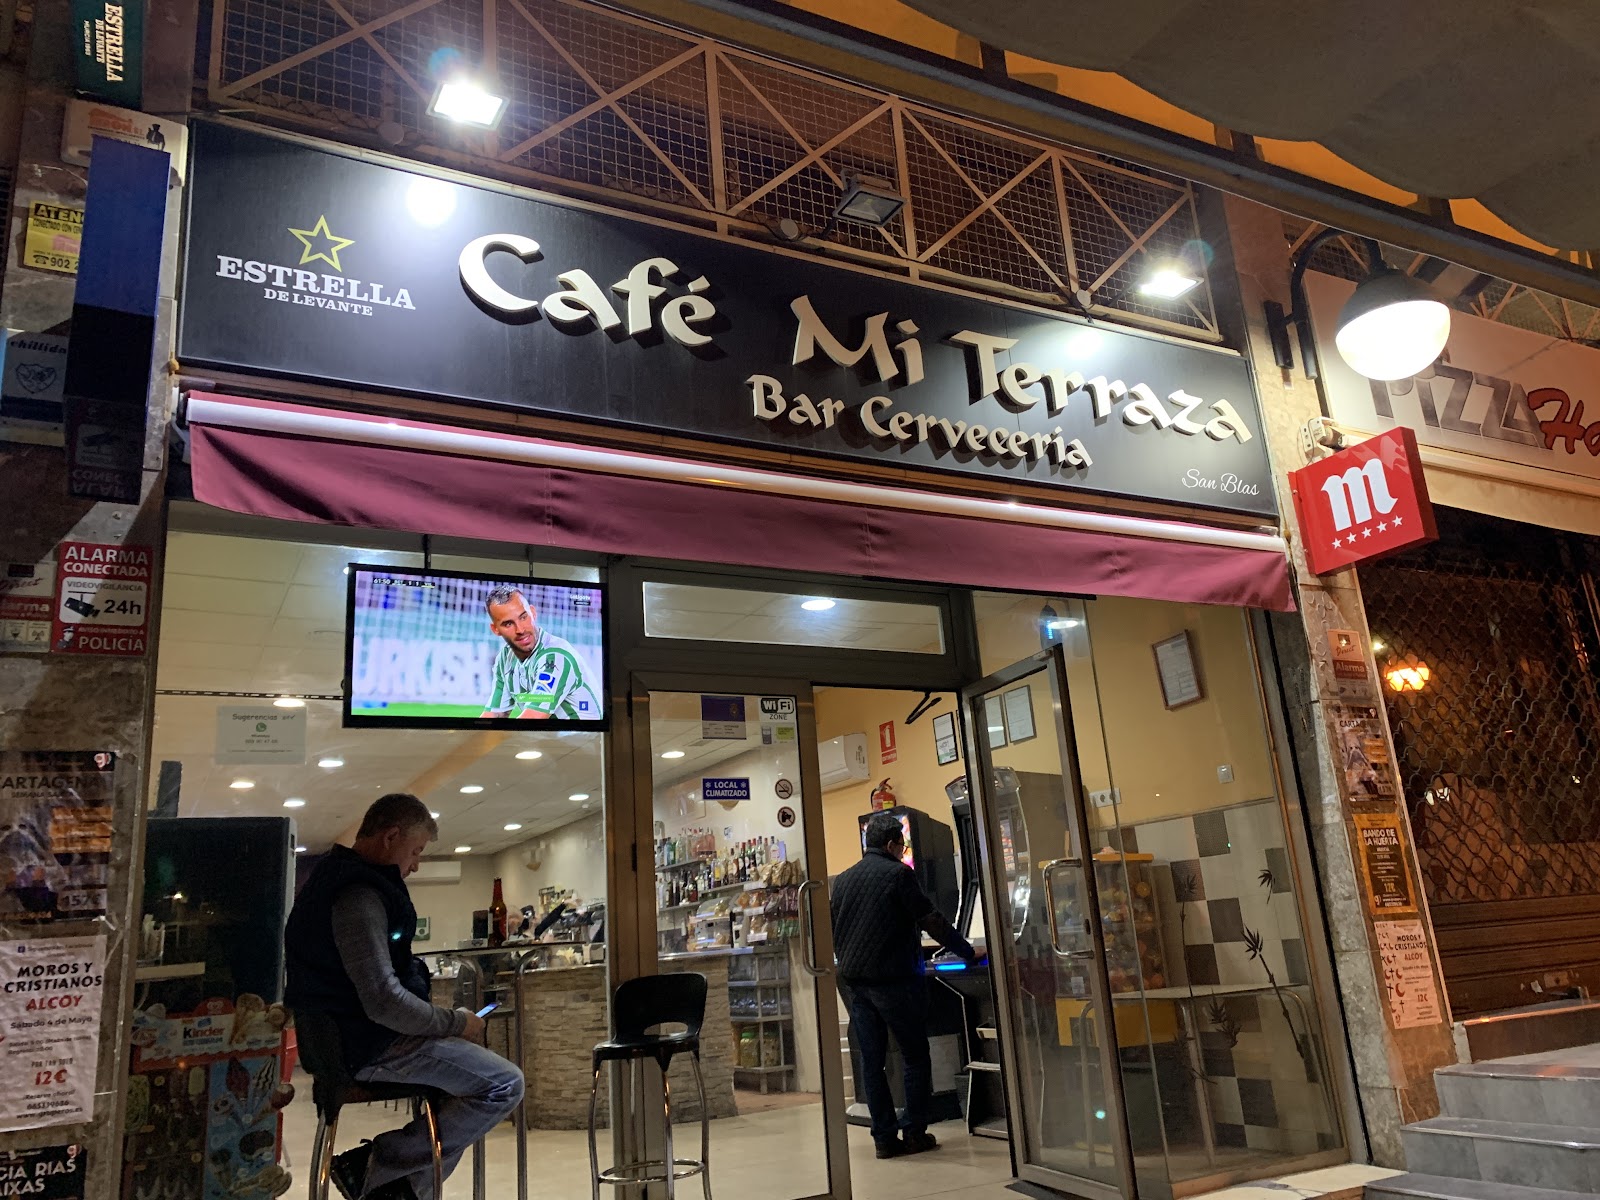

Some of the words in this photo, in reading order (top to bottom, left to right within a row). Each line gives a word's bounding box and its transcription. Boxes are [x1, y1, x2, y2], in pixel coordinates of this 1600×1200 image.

[95, 19, 105, 31] DE
[95, 30, 105, 64] LEVANTE
[104, 2, 123, 82] ESTRELLA
[50, 257, 71, 269] 902
[215, 255, 416, 310] ESTRELLA
[459, 233, 717, 346] Café
[263, 288, 289, 303] DE
[292, 292, 373, 316] LEVANTE
[789, 294, 925, 386] Mi
[948, 328, 1254, 446] Terraza
[745, 374, 846, 430] Bar
[1181, 468, 1218, 490] San
[1220, 472, 1260, 496] Blas
[65, 546, 149, 565] ALARMA
[63, 562, 148, 577] CONECTADA
[66, 581, 143, 592] VIDEOVIGILANCIA
[103, 599, 142, 615] 24h
[1335, 661, 1365, 673] Alarma
[232, 713, 278, 722] Sugerencias
[0, 776, 105, 790] ARTAGENA
[713, 781, 739, 789] LOCAL
[705, 789, 748, 797] CLIMATIZADO
[1363, 829, 1386, 838] BANDO
[1386, 829, 1396, 838] DE
[1394, 942, 1427, 951] CRISTIANOS
[1404, 952, 1423, 960] ALCOY
[17, 963, 79, 978] MOROS
[84, 962, 93, 974] Y
[4, 975, 102, 993] CRISTIANOS
[25, 994, 84, 1011] ALCOY
[55, 1018, 67, 1026] de
[68, 1015, 93, 1025] Mayo
[35, 1158, 77, 1178] RIAS
[0, 1178, 46, 1197] IXAS
